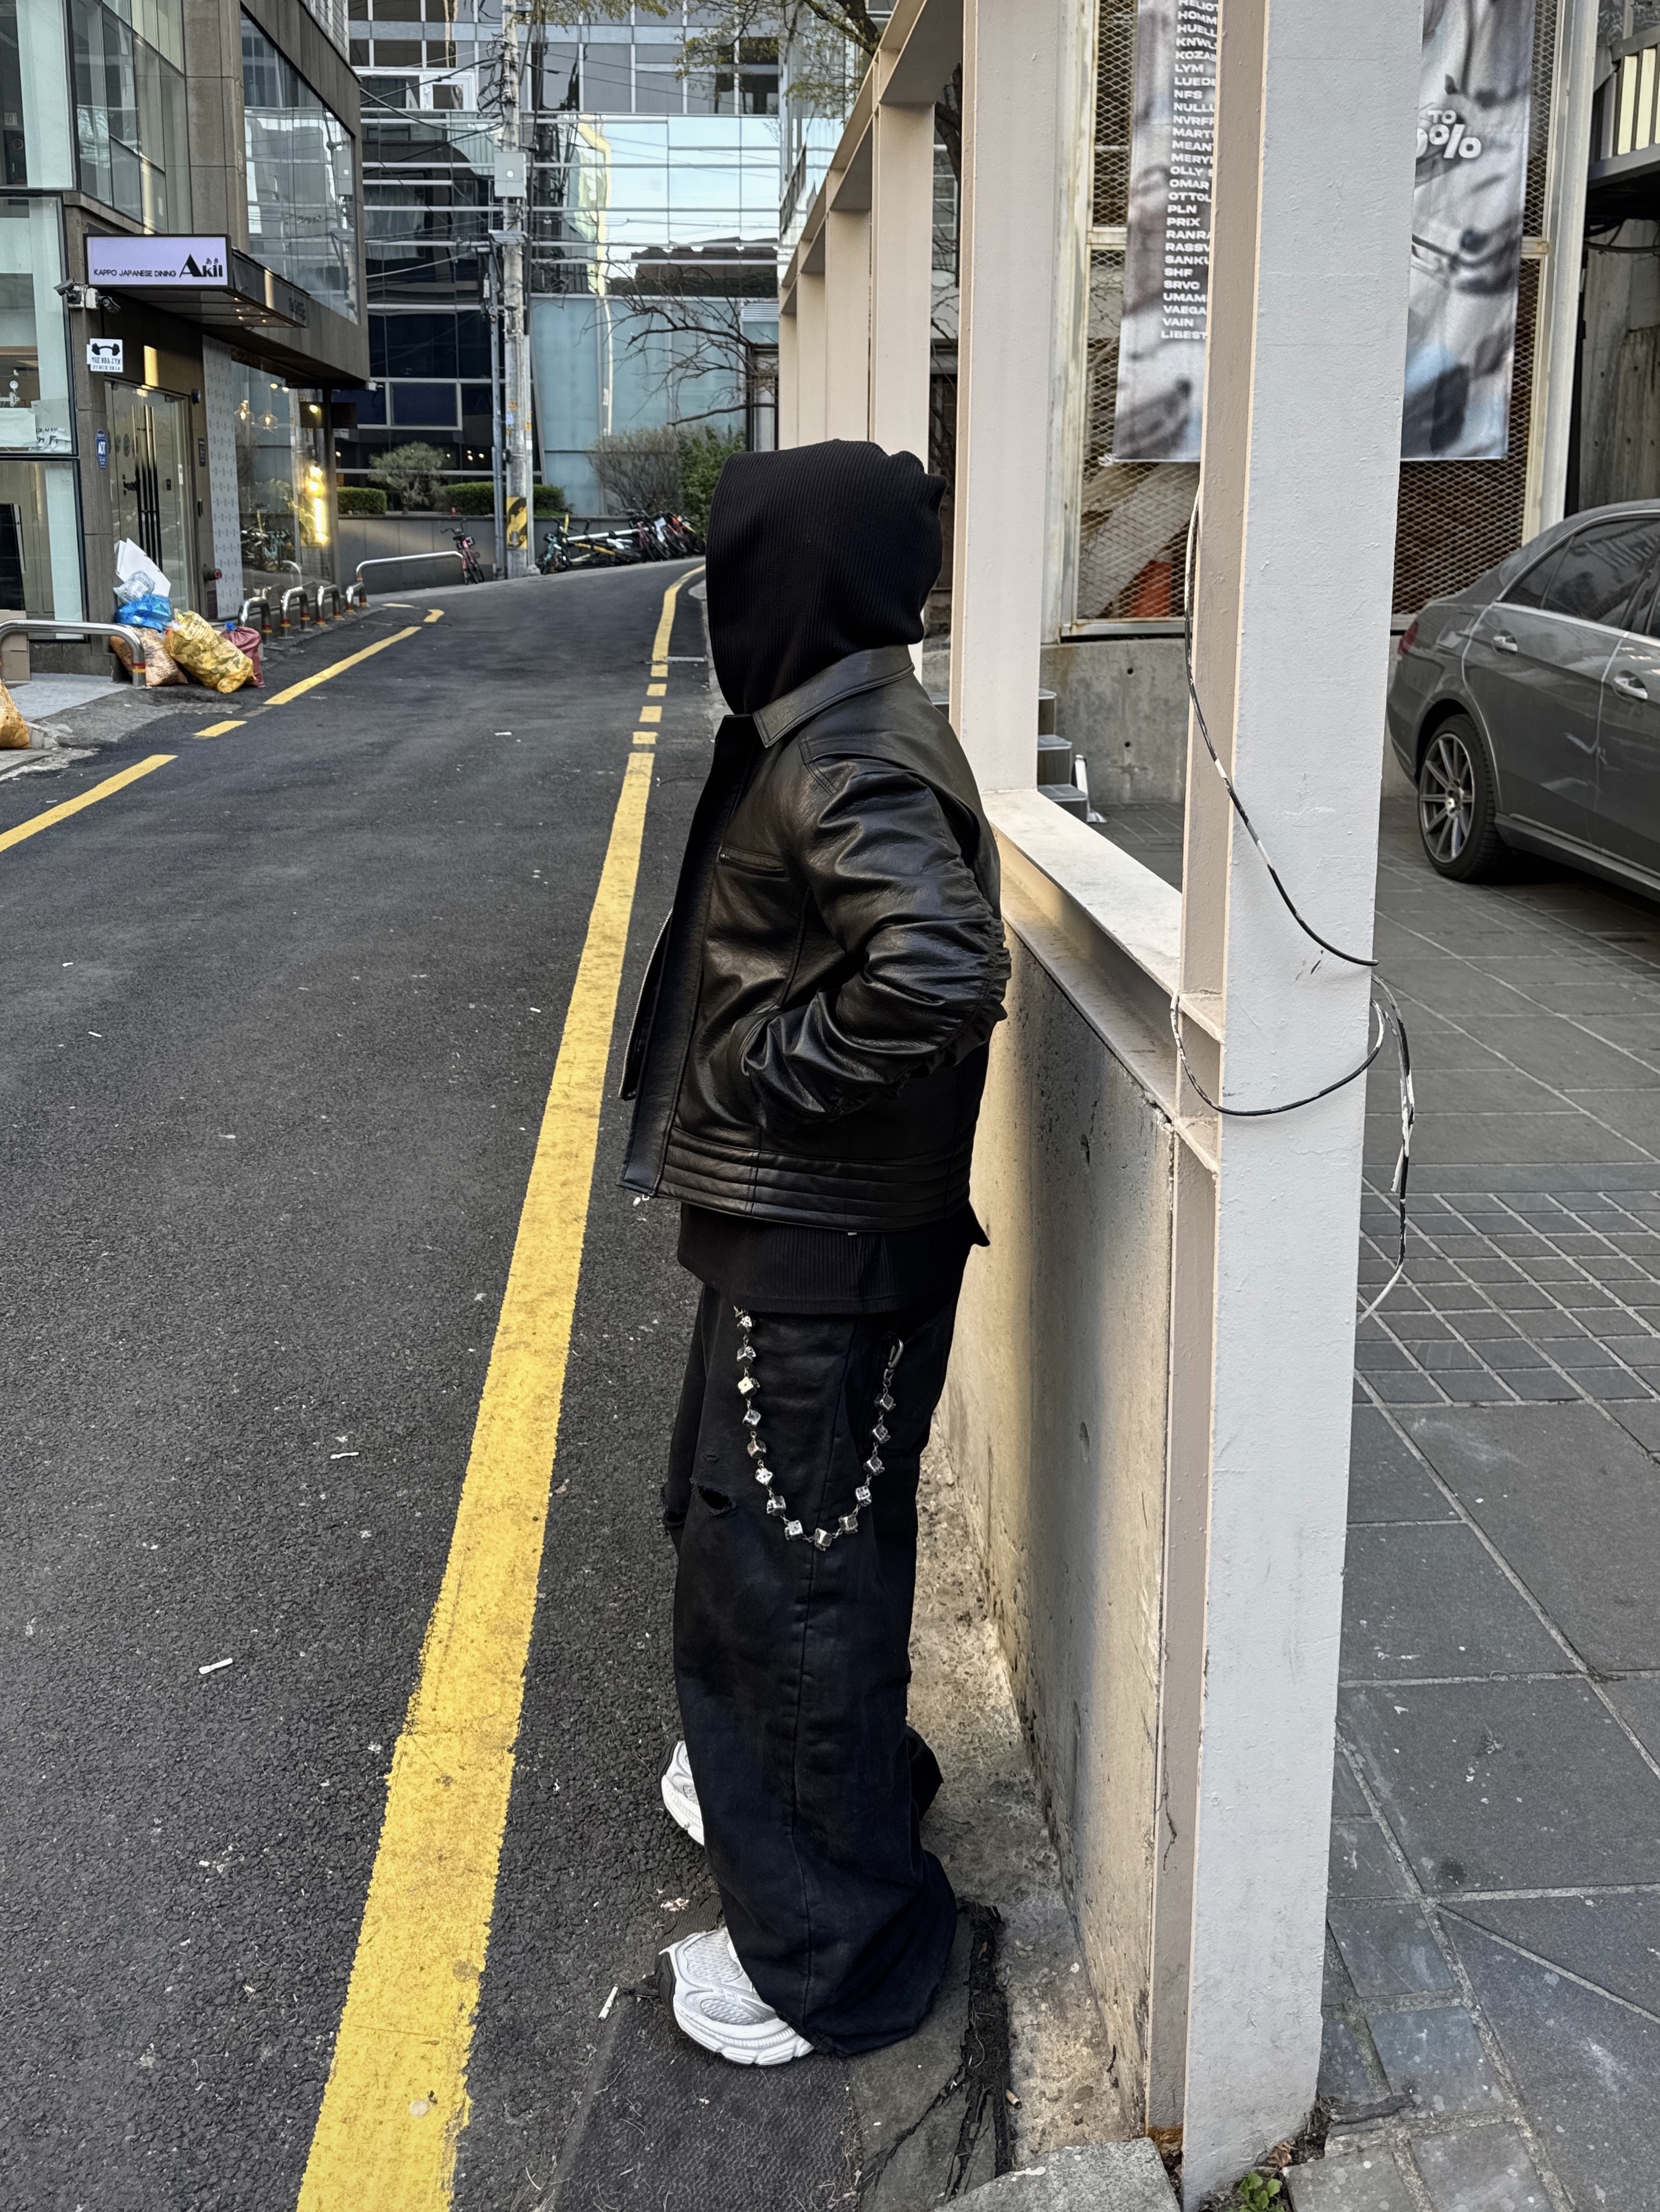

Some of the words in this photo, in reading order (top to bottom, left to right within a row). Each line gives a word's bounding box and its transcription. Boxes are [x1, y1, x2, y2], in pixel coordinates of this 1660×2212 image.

[1176, 24, 1217, 37] HUELL
[1174, 64, 1204, 73] LYM
[1174, 89, 1203, 100] NFS
[1427, 109, 1457, 124] TO
[1171, 140, 1213, 151] MEAN
[1170, 165, 1204, 176] OLLY
[1168, 178, 1210, 190] OMAR
[1168, 191, 1211, 202] OTTOL
[1167, 204, 1197, 214] PLN
[1166, 217, 1201, 227] PRIX
[1164, 267, 1193, 278] SHF
[1162, 317, 1194, 327] VAIN
